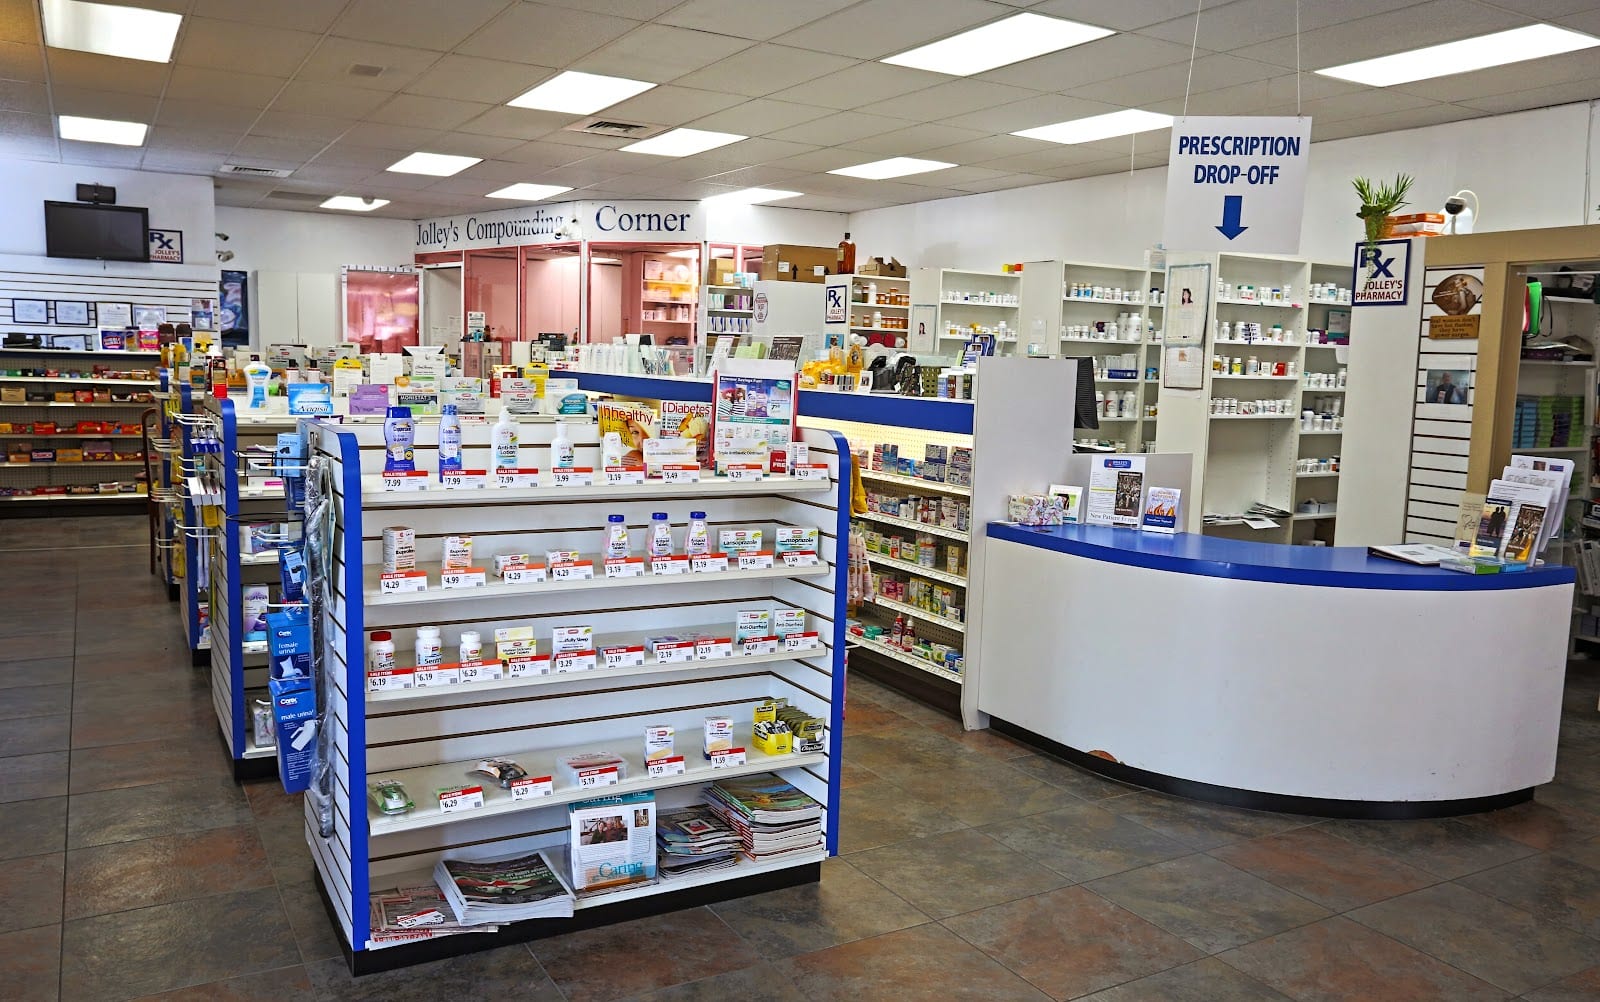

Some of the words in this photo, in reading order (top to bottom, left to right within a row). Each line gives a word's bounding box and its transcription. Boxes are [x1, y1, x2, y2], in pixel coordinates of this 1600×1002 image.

[1179, 136, 1300, 156] PRESCRIPTION
[1194, 165, 1279, 184] DROP-OFF
[416, 221, 459, 248] Jolley's
[466, 210, 563, 244] Compounding
[595, 205, 691, 232] Corner
[1355, 291, 1402, 301] PHARMACY
[667, 402, 710, 414] Diabetes
[611, 405, 653, 425] healthy
[443, 576, 459, 584] $4.99
[383, 581, 399, 589] $4.29
[511, 664, 526, 672] $2.19
[417, 673, 433, 681] $6.19
[370, 678, 386, 686] $6.19
[443, 800, 457, 808] $6.29
